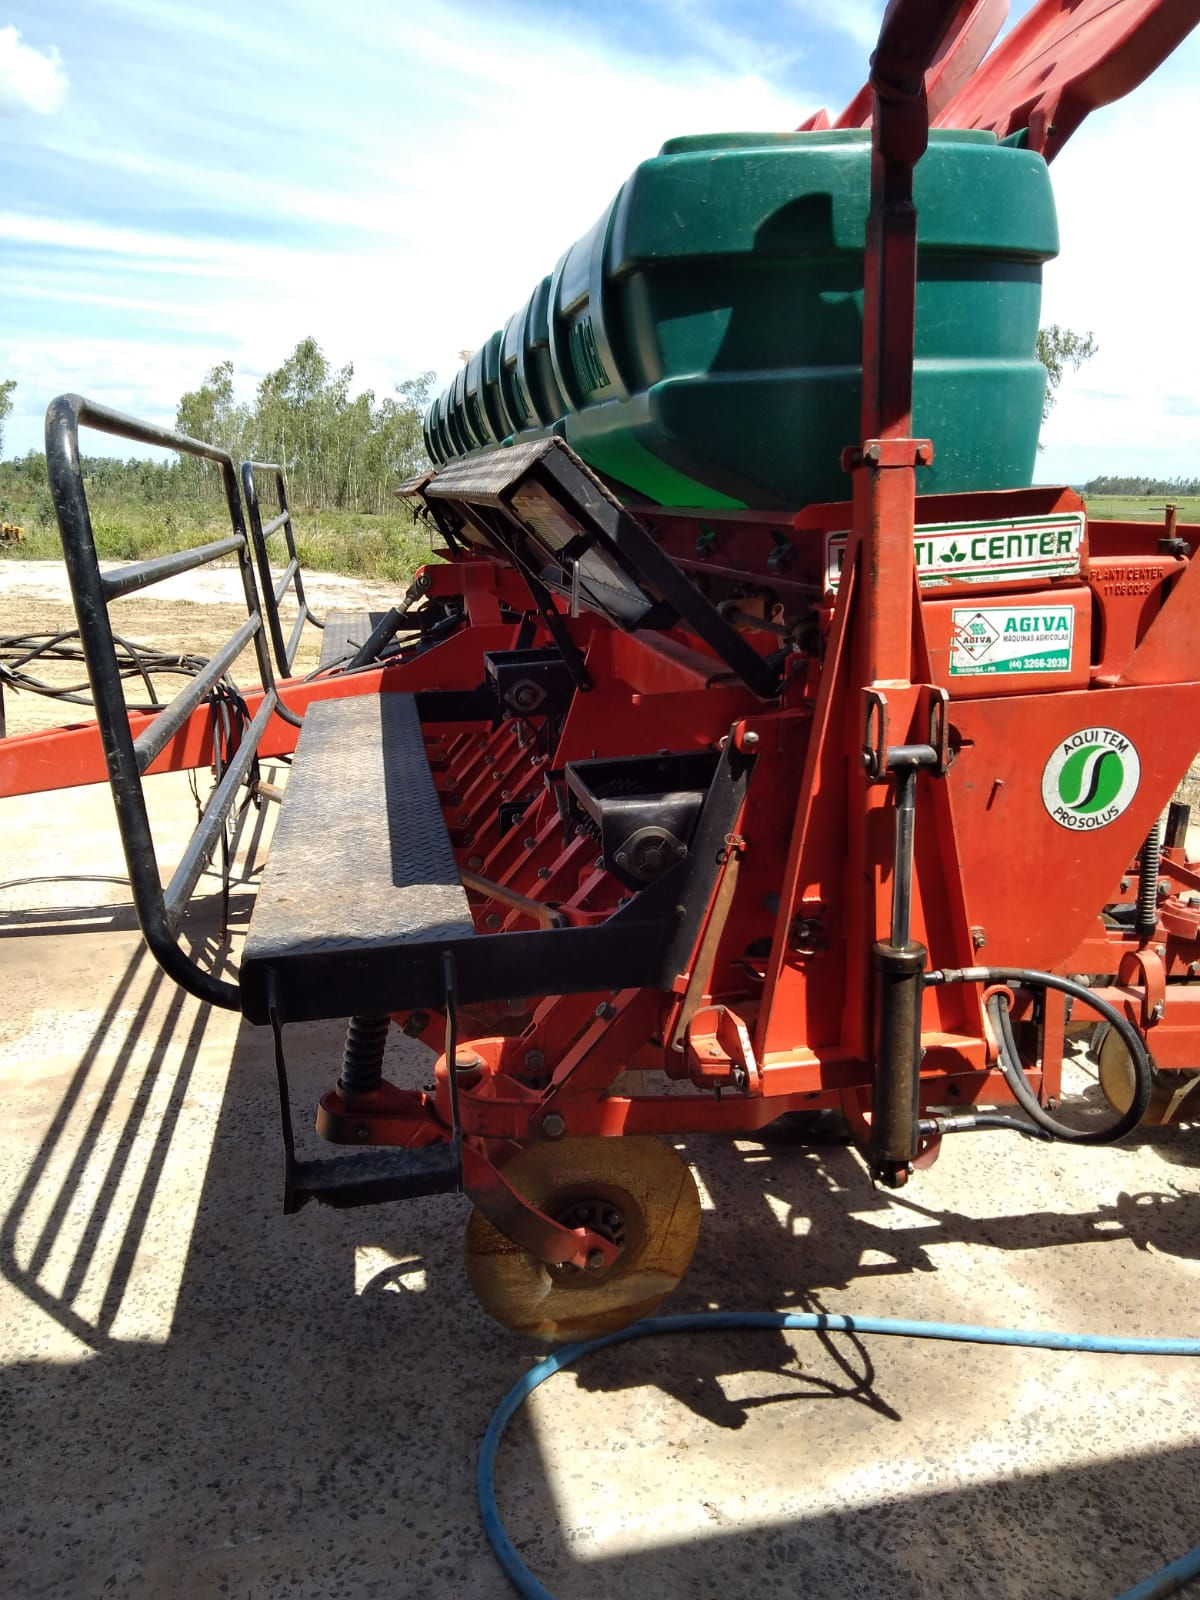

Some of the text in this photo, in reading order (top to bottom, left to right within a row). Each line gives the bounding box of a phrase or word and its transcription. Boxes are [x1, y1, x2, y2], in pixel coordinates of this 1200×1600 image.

[971, 531, 1072, 560] CENTER
[1090, 567, 1125, 582] PLANTI
[1127, 566, 1164, 581] CENTER
[1004, 616, 1068, 632] AGIVA
[963, 636, 992, 644] AGIVA
[1003, 631, 1068, 642] MÁQUINAS AGRÍCOLAS
[1009, 657, 1067, 670] (44) 3266-2039
[1063, 731, 1129, 755] AQUI TEM
